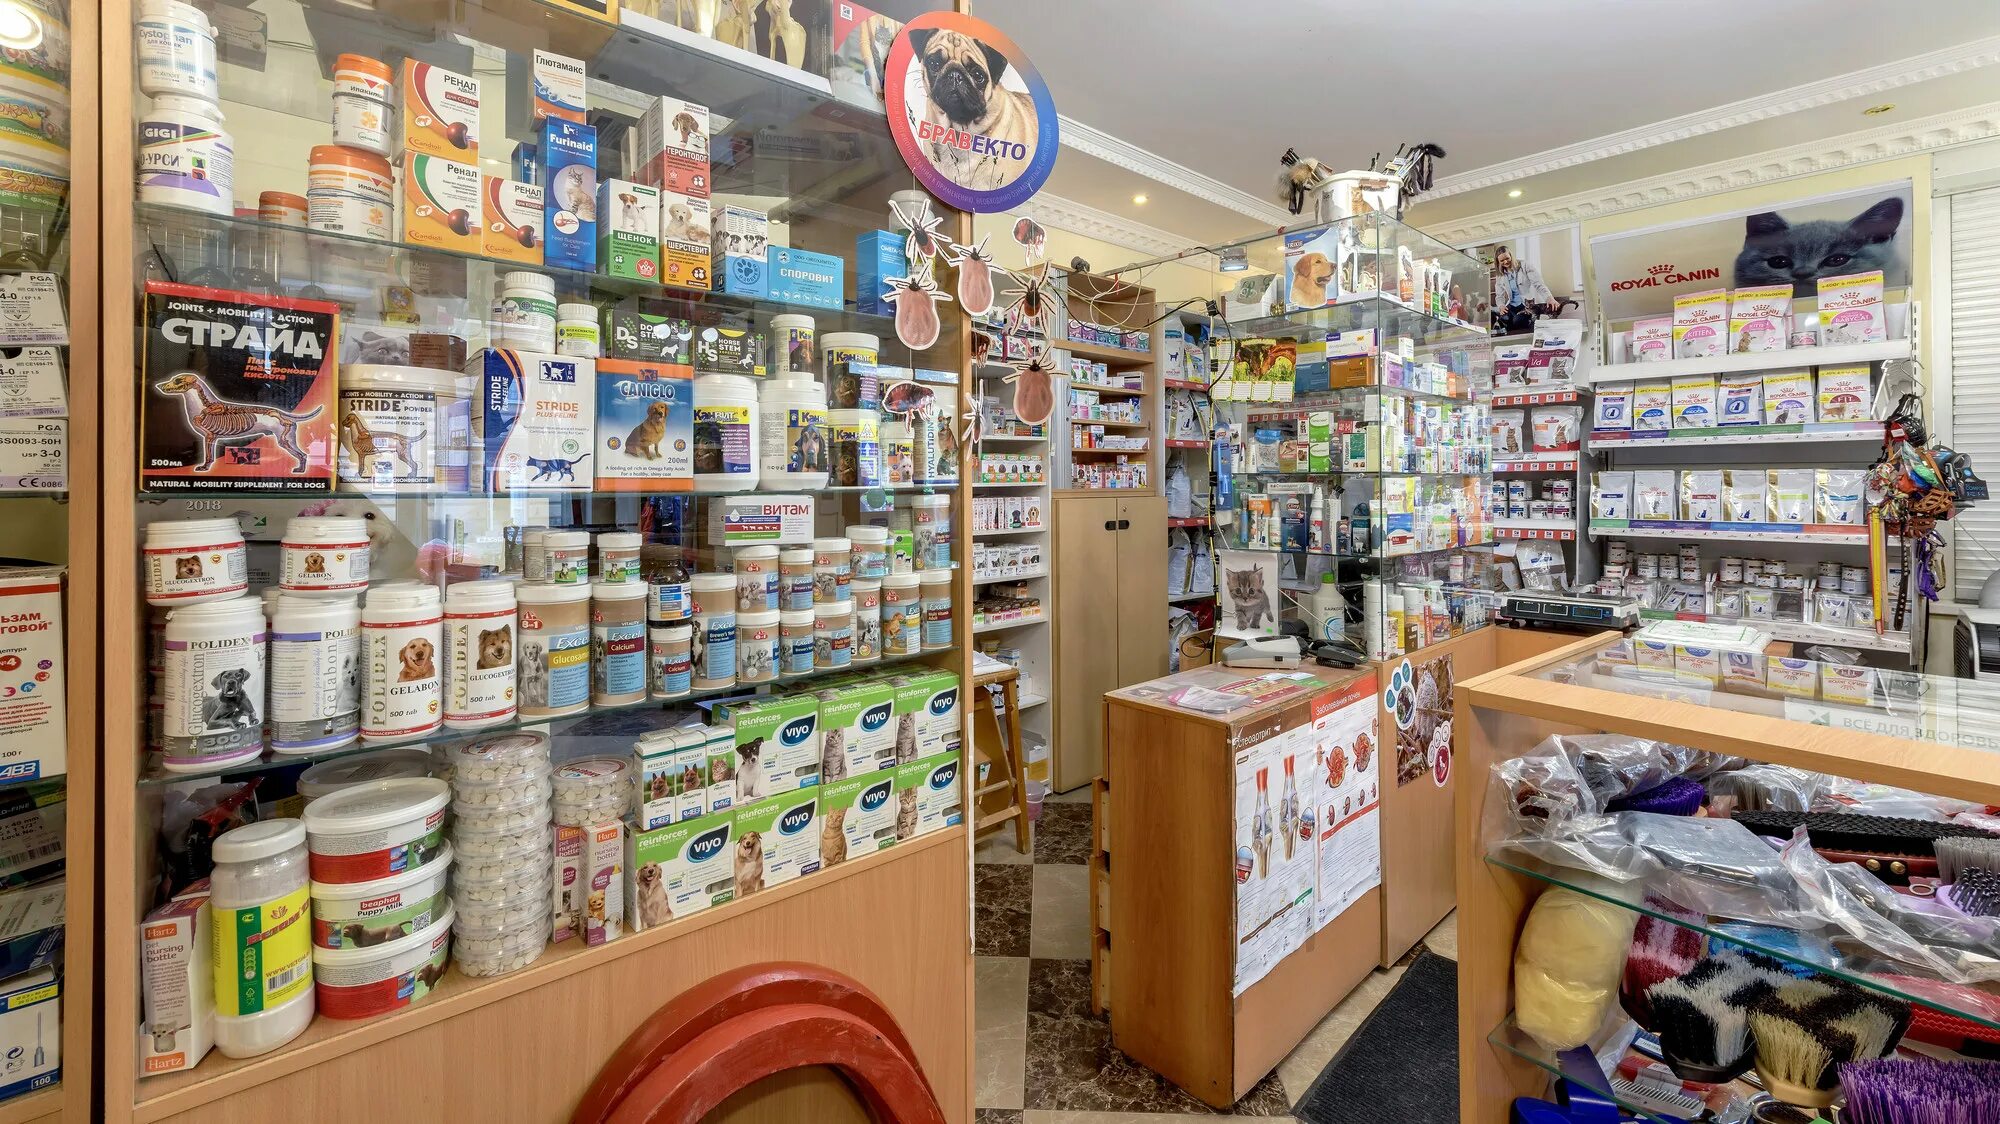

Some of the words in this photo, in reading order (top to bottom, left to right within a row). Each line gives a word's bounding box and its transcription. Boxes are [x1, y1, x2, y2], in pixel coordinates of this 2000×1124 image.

[140, 29, 193, 45] Cystopan
[536, 54, 583, 75] Глютамакс
[444, 74, 477, 92] РЕНАЛ
[458, 96, 478, 106] СОБАК
[145, 128, 177, 138] GIGI
[550, 134, 593, 152] Furinaid
[918, 120, 1026, 161] БРАВЕКТО
[666, 147, 708, 162] ГЕРОНТОДОГ
[447, 164, 478, 178] Ренал
[514, 185, 542, 197] РЕНАЛ
[617, 232, 652, 244] ЩЕНОК
[668, 241, 708, 254] ШЕРСТЕВИТ
[780, 268, 834, 284] СПОРОВИТ
[1611, 276, 1657, 292] ROYAL
[1664, 268, 1720, 285] CANIN
[1850, 296, 1876, 306] CANIN
[168, 302, 204, 314] JOINTS
[216, 306, 266, 319] MOBILITY
[277, 314, 314, 325] ACTION
[1700, 314, 1720, 322] CANIN
[161, 317, 322, 360] СТРАЙД
[1688, 329, 1712, 338] KITTEN
[718, 338, 740, 346] HORSE
[718, 344, 741, 352] STEM
[243, 372, 286, 381] кислота
[490, 376, 501, 411] STRIDE
[620, 380, 676, 398] CANIGLO
[350, 400, 401, 412] STRIDE
[536, 400, 579, 412] STRIDE
[555, 410, 578, 418] FELINE
[40, 450, 62, 458] 3-0
[668, 456, 688, 464] 200ml
[193, 481, 233, 490] MOBILITY
[186, 500, 222, 512] 2018
[154, 555, 164, 592] POLIDEX
[286, 550, 294, 584] POLIDEX
[298, 572, 332, 580] GELABON
[611, 631, 642, 641] Excel
[190, 638, 250, 650] POLIDEX
[610, 643, 635, 651] Calcium
[455, 624, 468, 710] POLIDEX
[323, 644, 338, 717] Gelabon
[372, 634, 386, 726] POLIDEX
[188, 652, 206, 736] Glucogextron
[484, 694, 496, 702] tab
[897, 686, 930, 699] reinforces
[824, 701, 862, 714] reinforces
[1316, 698, 1348, 716] Заболевания
[1348, 692, 1360, 705] почек
[390, 710, 404, 718] 500
[406, 708, 418, 716] tab
[739, 712, 782, 728] reinforces
[1844, 717, 1872, 731] ВСЁ
[1876, 723, 1910, 738] ДЛЯ
[204, 734, 242, 746] 300
[1, 763, 36, 778] АВЗ
[898, 762, 931, 776] reinforces
[824, 782, 861, 797] reinforces
[736, 804, 780, 820] reinforces
[598, 831, 617, 842] Hartz
[638, 828, 688, 848] reinforces
[362, 894, 400, 910] beaphar
[357, 907, 384, 918] Puppy
[385, 902, 404, 912] Milk
[148, 927, 174, 938] Hartz
[146, 944, 184, 956] nursing
[146, 952, 177, 963] bottle
[149, 1056, 182, 1070] Hartz
[33, 1076, 51, 1086] 100
